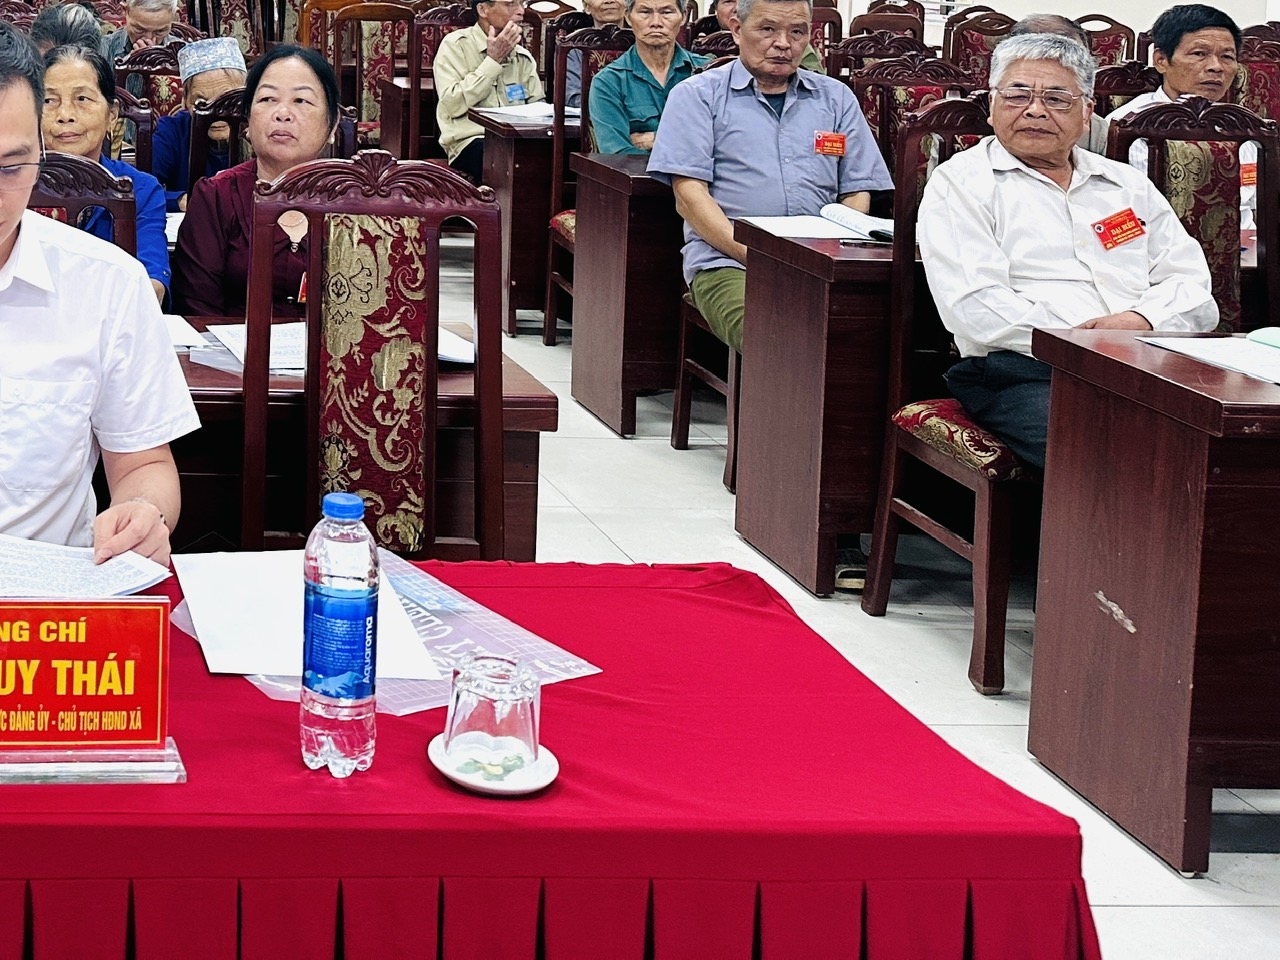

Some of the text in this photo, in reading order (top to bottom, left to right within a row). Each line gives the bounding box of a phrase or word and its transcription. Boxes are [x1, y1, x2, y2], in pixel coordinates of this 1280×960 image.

[39, 616, 87, 643] CHÍ
[362, 615, 373, 685] Aquaroma
[51, 652, 136, 696] THÁI
[8, 703, 36, 732] ĐẢNG
[37, 703, 50, 732] ỦY
[57, 704, 77, 731] CHỦ
[78, 711, 100, 736] TỊCH
[101, 710, 128, 731] HĐND
[128, 706, 142, 730] XÃ
